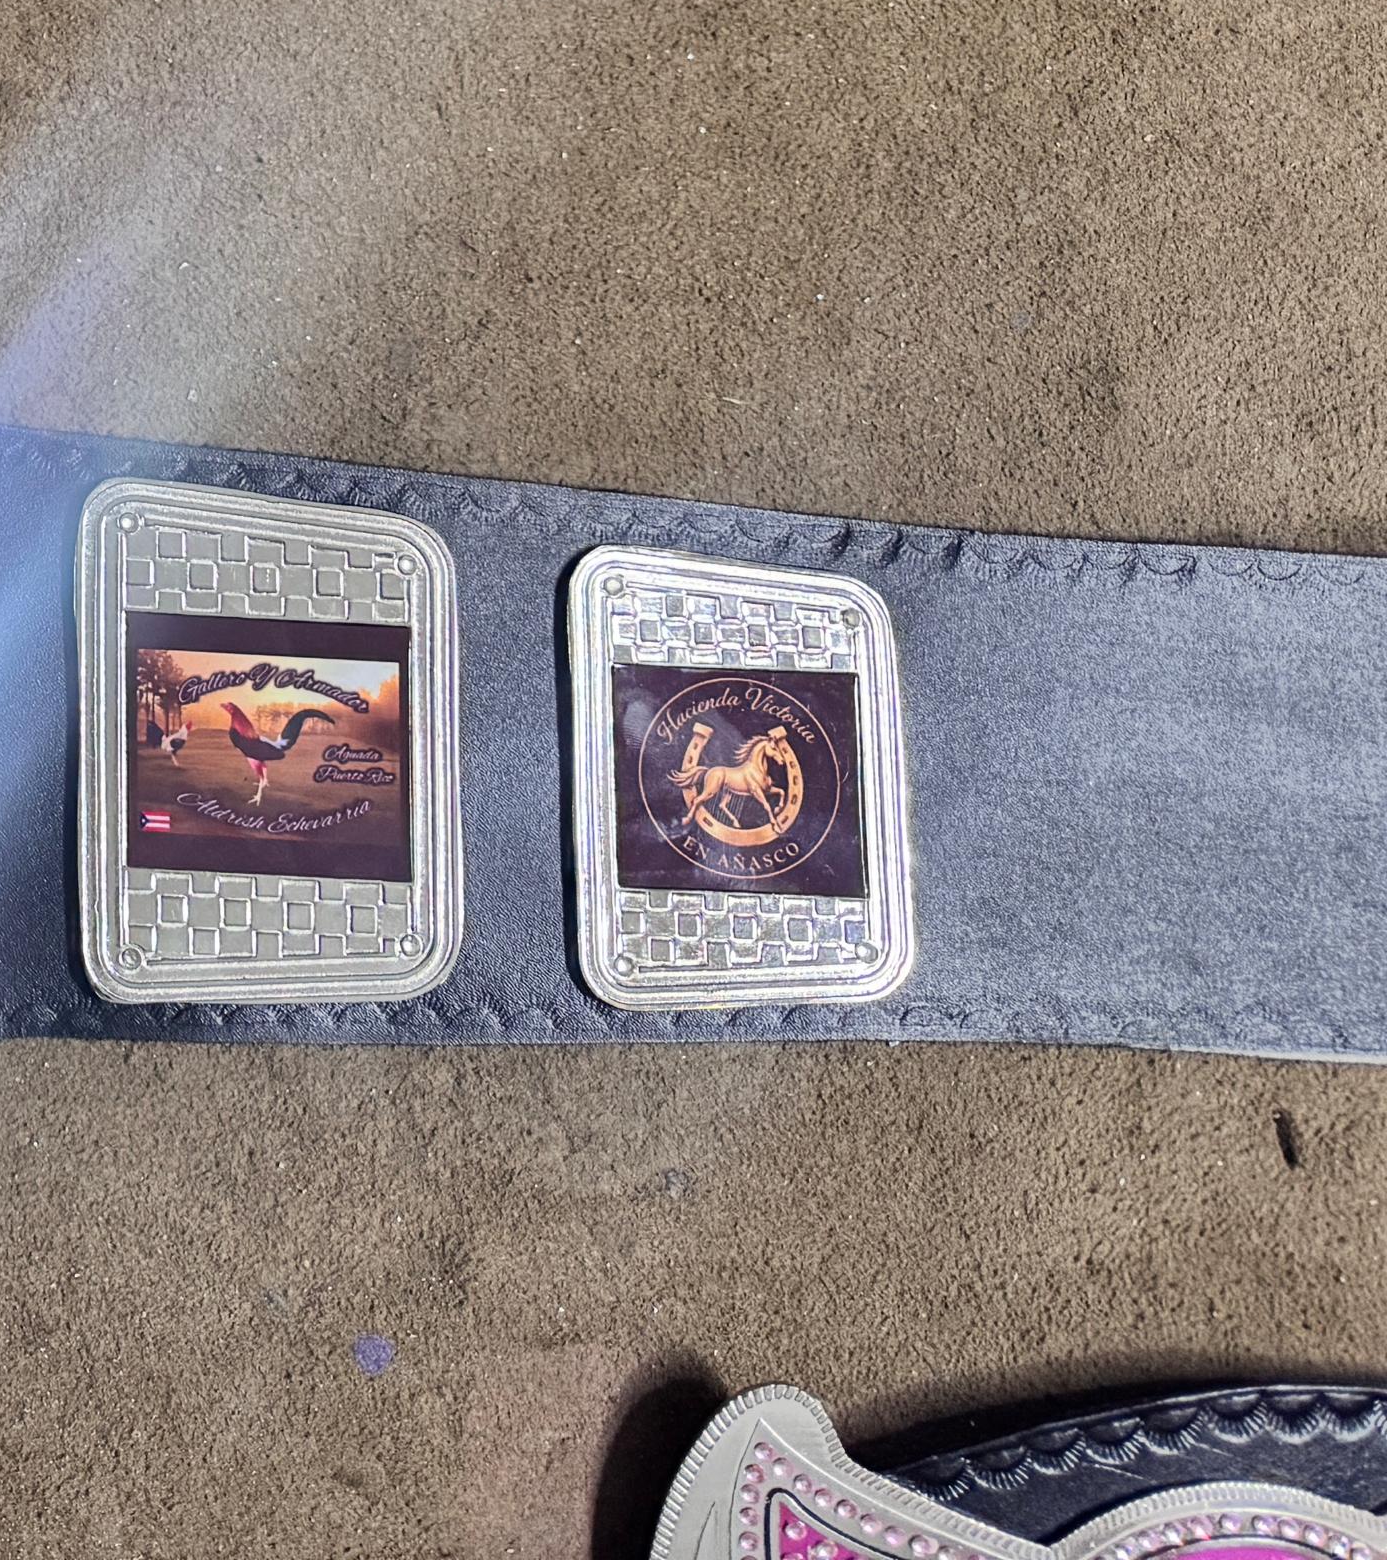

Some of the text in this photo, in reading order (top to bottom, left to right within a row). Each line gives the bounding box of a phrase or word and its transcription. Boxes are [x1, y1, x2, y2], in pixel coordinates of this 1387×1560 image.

[178, 663, 369, 713] Gallero Y Armador
[657, 687, 818, 745] Hacienda Victoria
[324, 744, 381, 763] Aguada
[315, 766, 366, 783] Puerto
[178, 792, 372, 833] Aldrish Echevarria
[683, 835, 800, 872] EN AÑASCO
